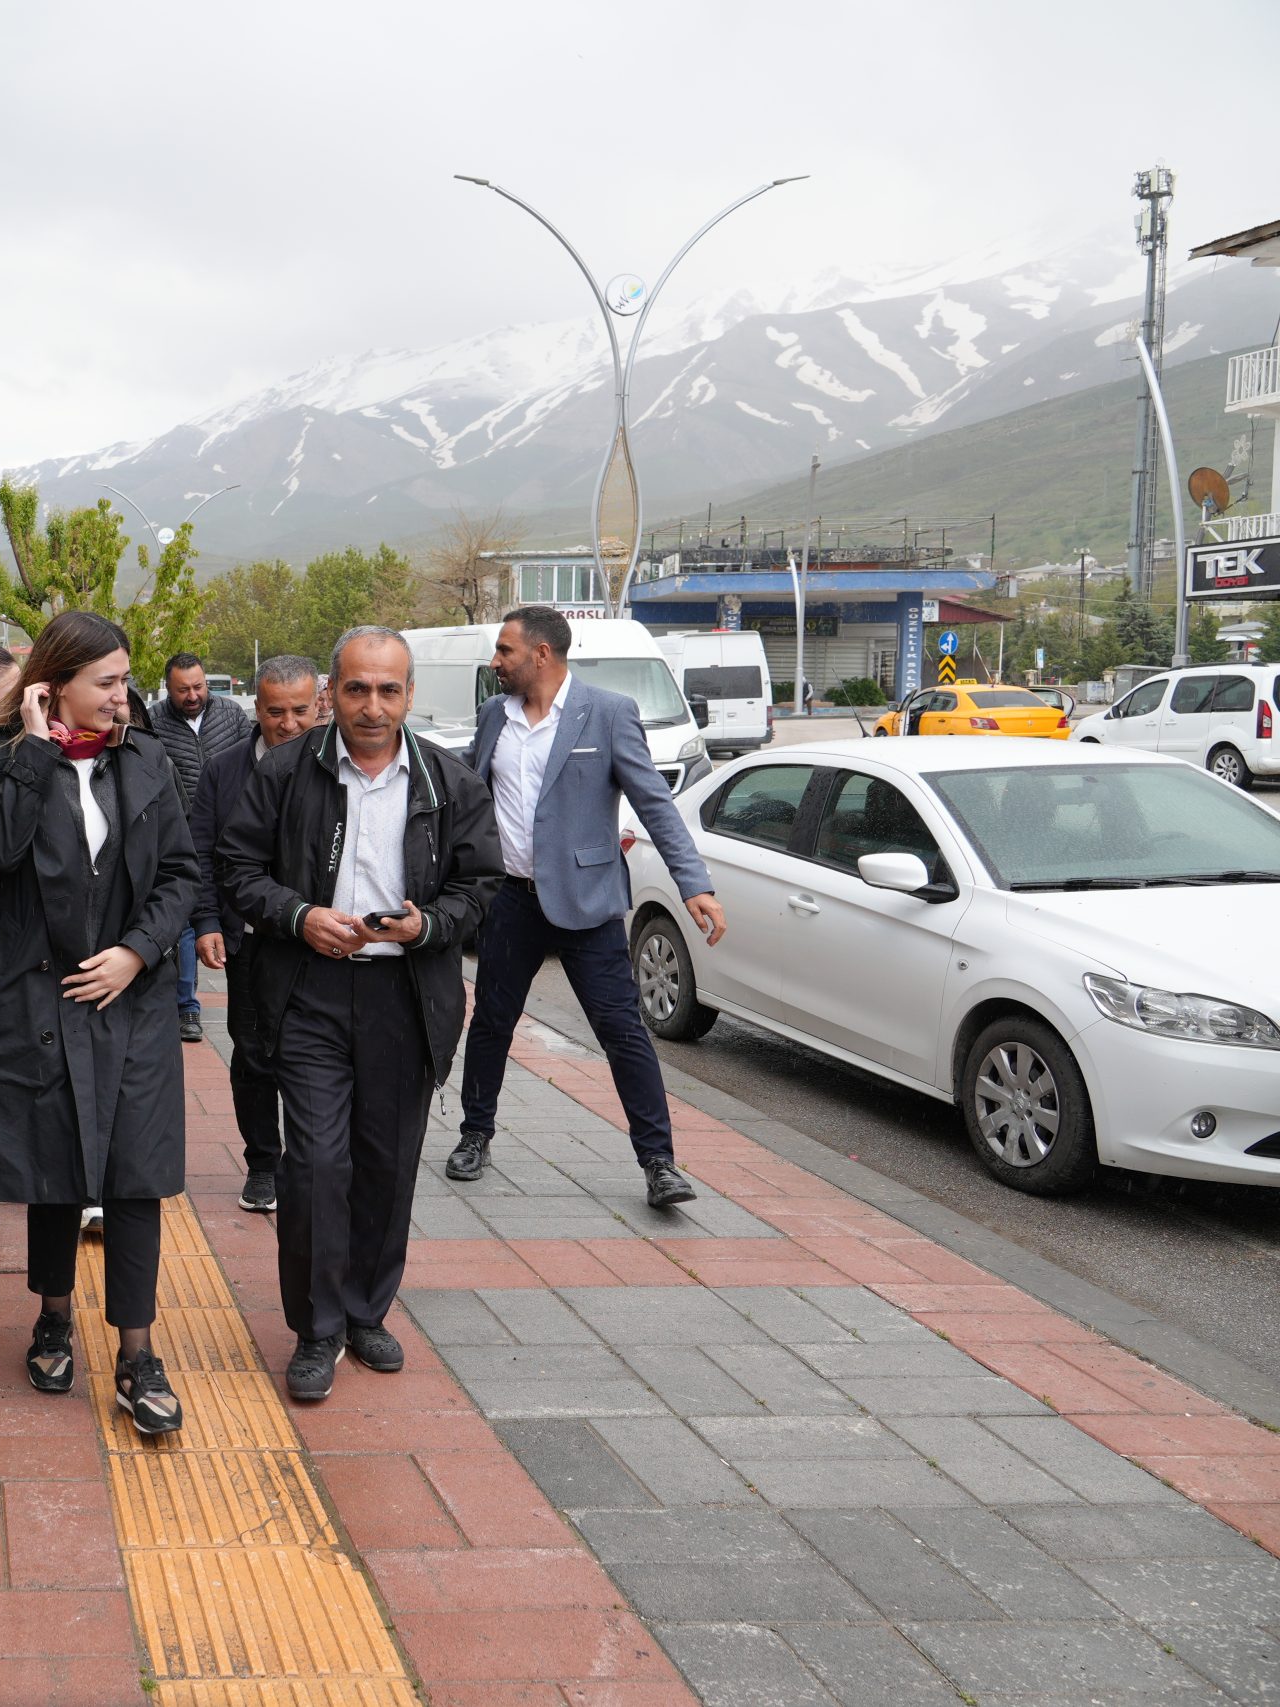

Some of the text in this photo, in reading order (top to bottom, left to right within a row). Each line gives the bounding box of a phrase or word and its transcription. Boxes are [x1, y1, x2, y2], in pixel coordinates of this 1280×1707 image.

[1197, 548, 1264, 579] TEK
[560, 610, 606, 620] RASL
[328, 822, 344, 873] LACOSTE
